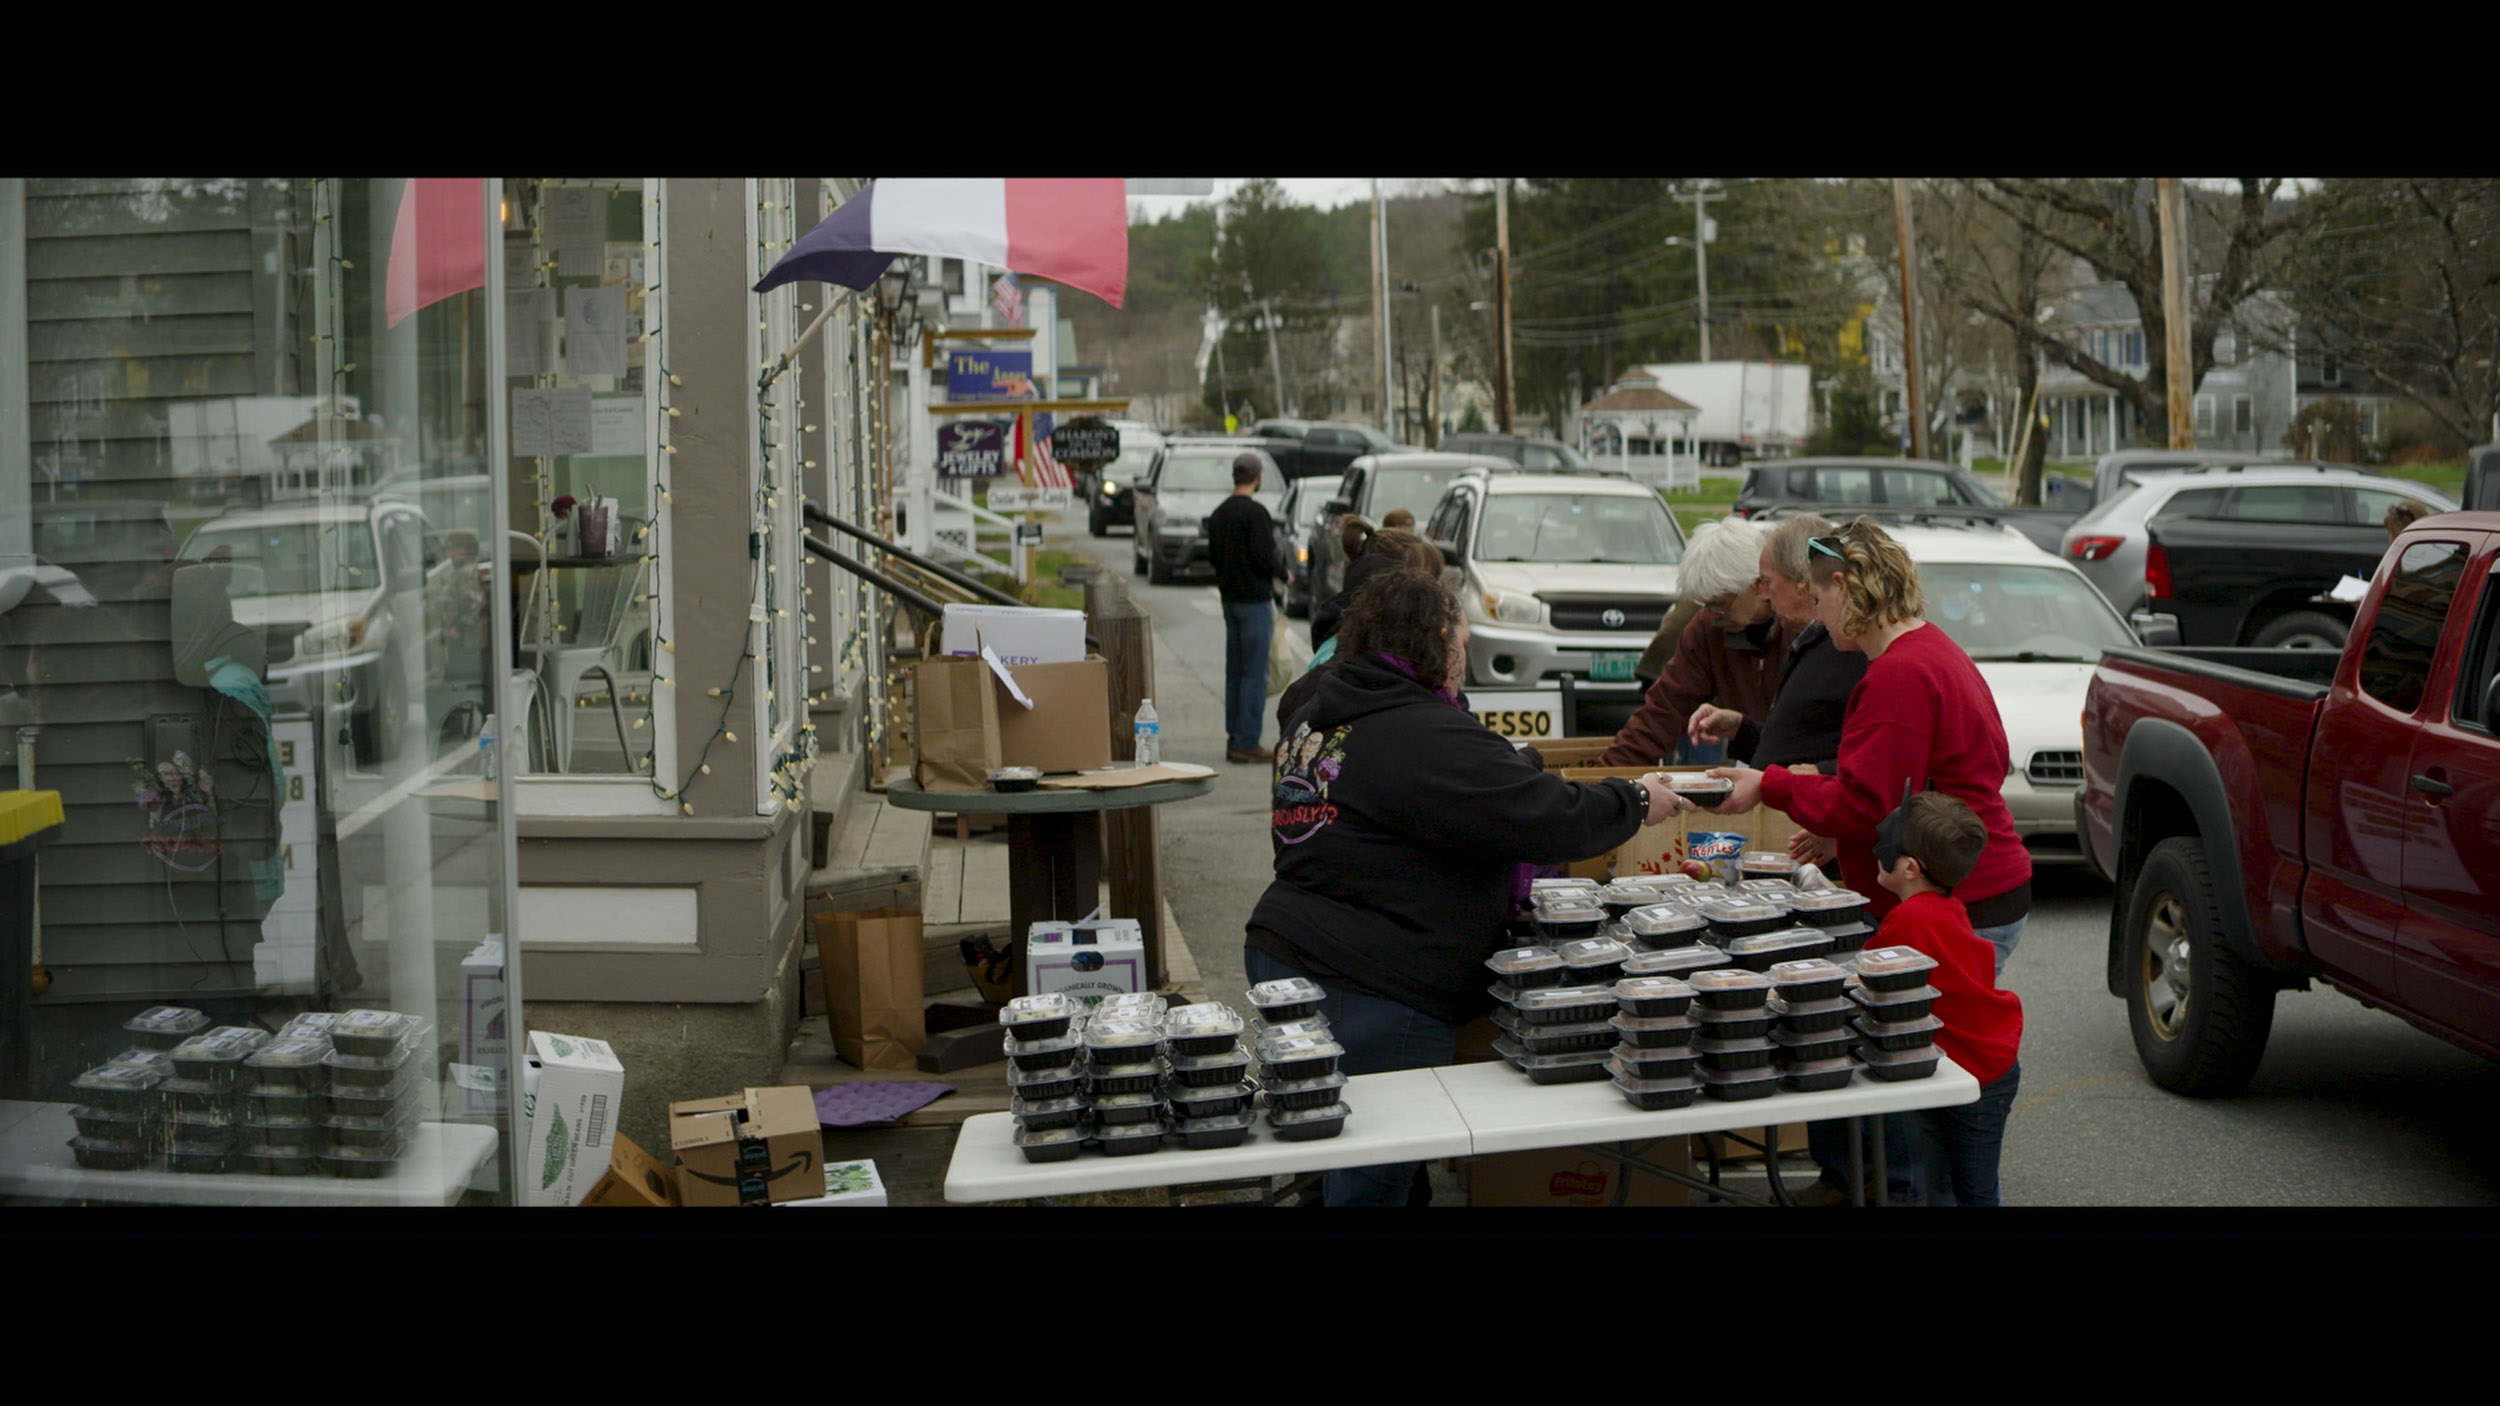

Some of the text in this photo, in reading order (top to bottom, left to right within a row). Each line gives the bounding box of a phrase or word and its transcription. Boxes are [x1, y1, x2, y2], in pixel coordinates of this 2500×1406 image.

[954, 355, 989, 375] The
[941, 449, 1000, 467] JEWELRY
[958, 461, 997, 476] GIFTS
[1475, 711, 1551, 736] ESSO
